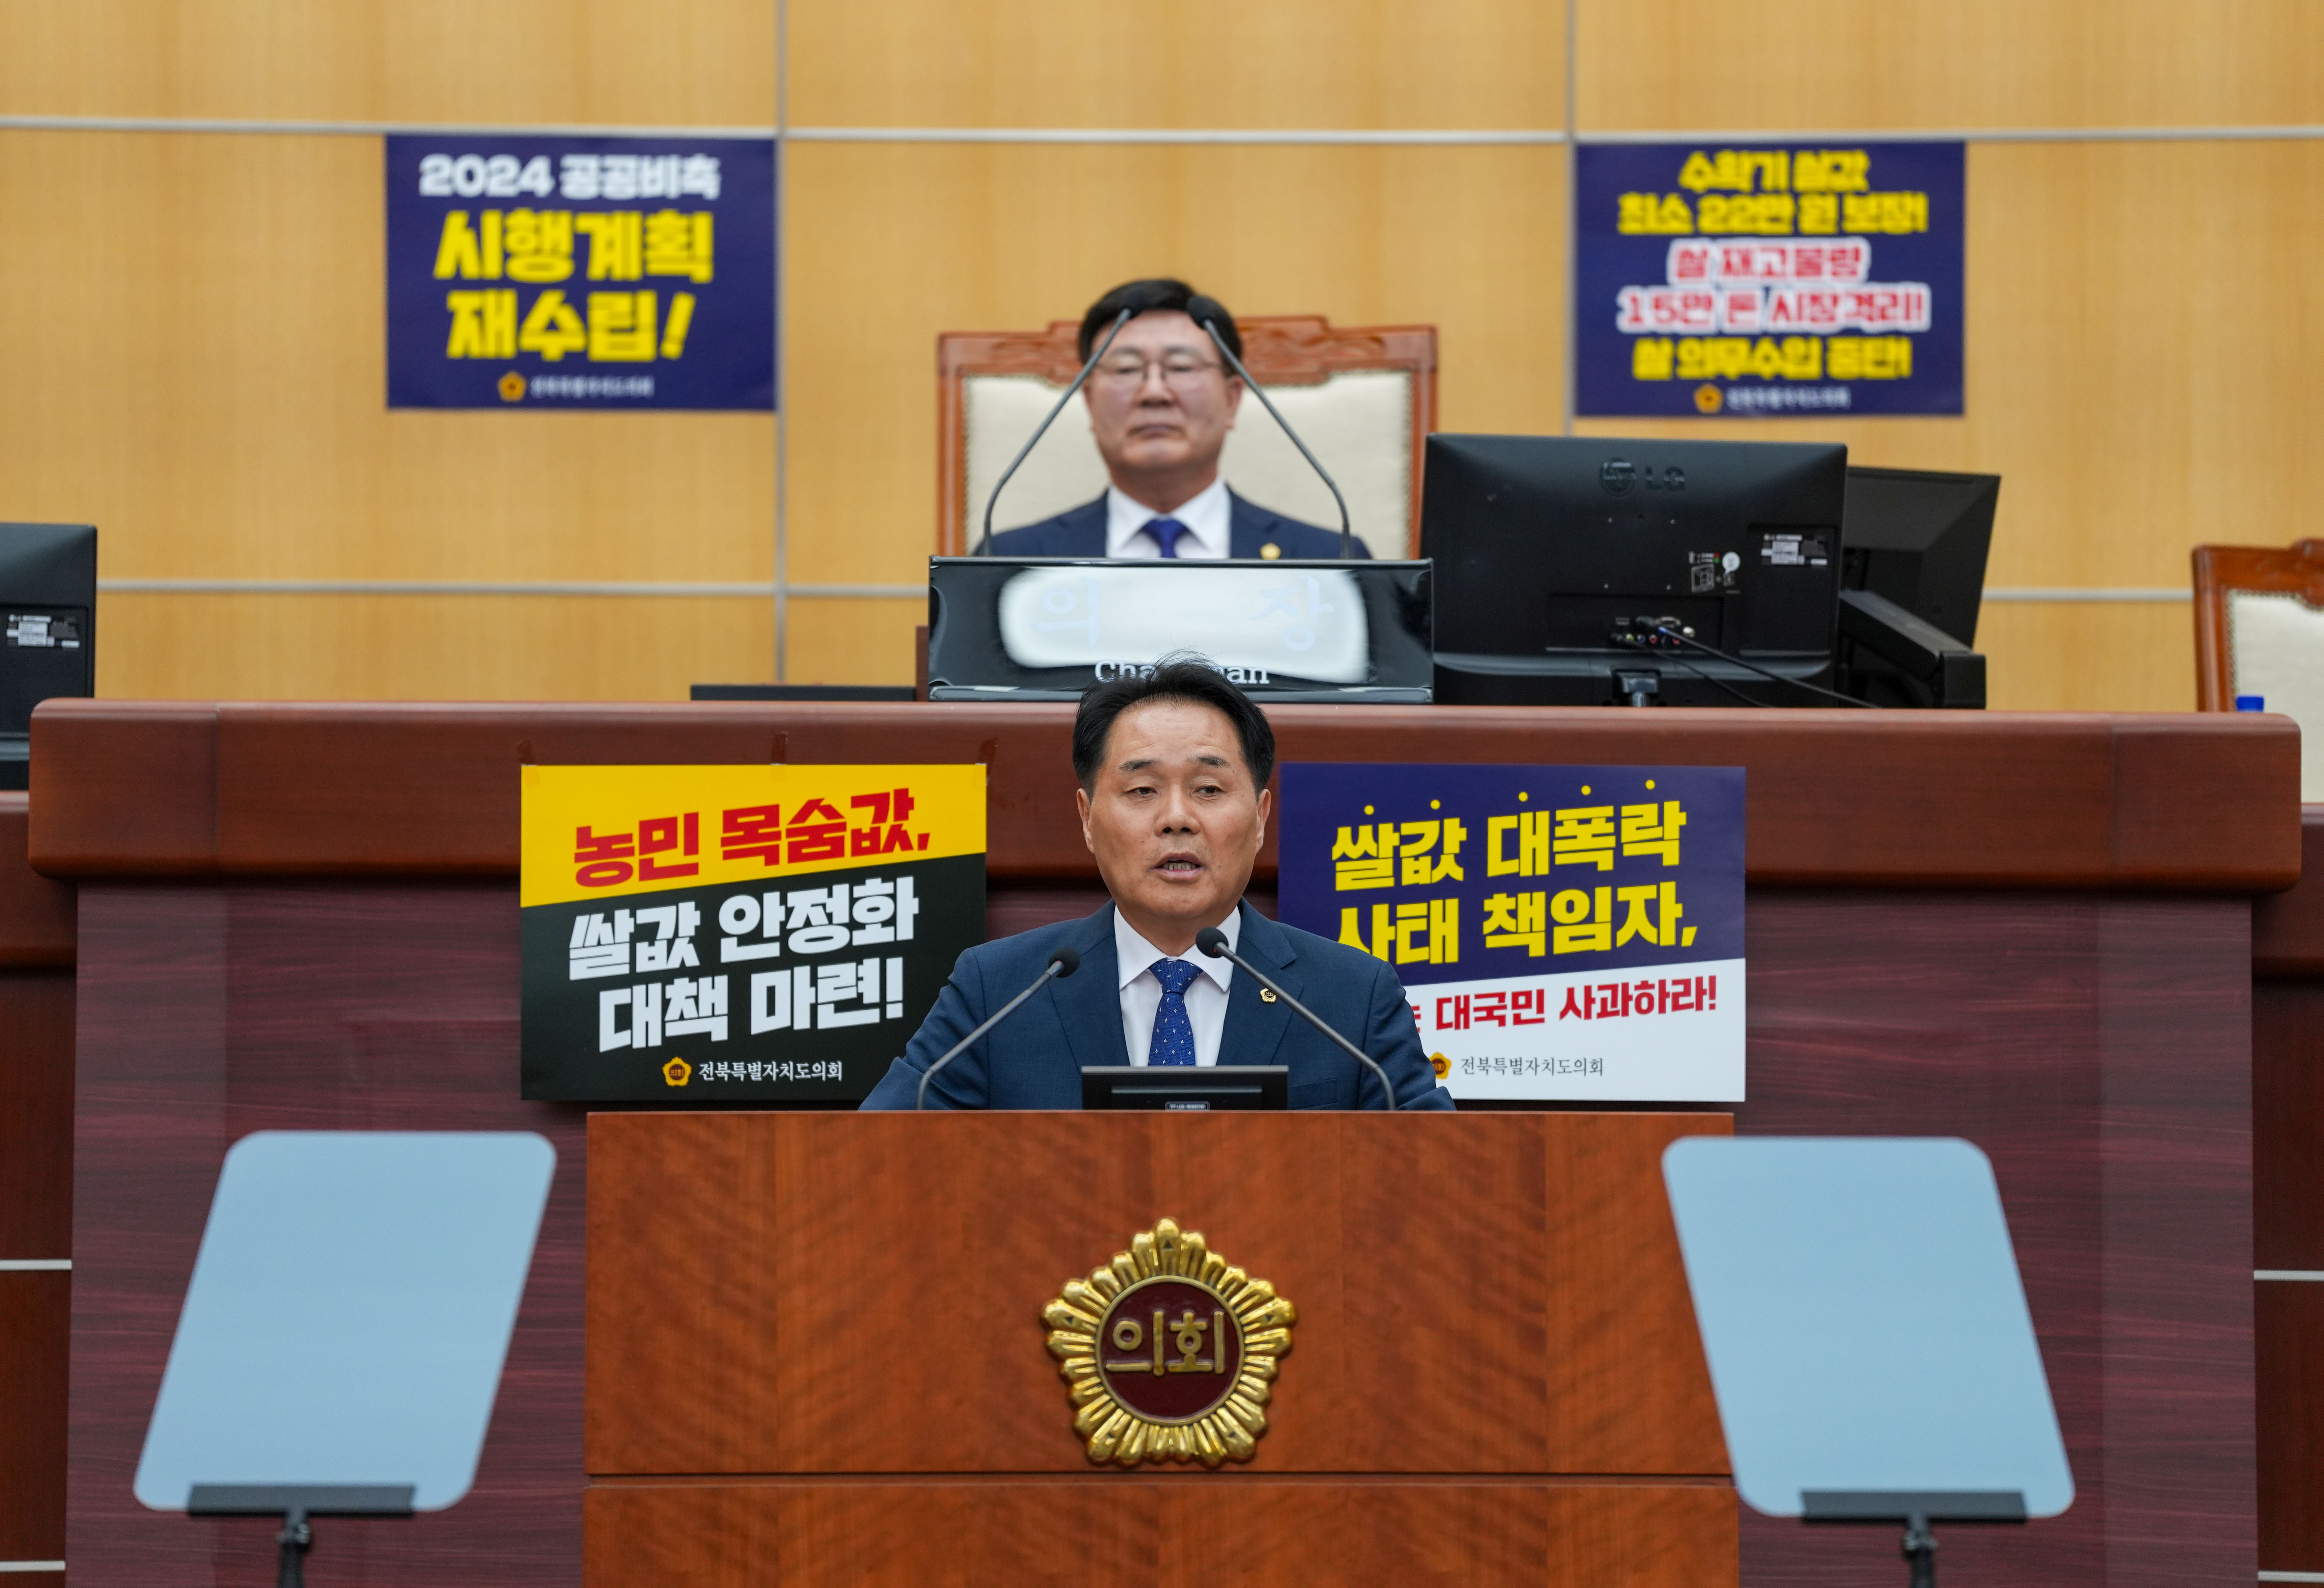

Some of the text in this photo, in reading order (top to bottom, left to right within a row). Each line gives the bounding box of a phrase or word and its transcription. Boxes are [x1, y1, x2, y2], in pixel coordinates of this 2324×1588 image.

[418, 153, 721, 199] 2024 공공비축
[1696, 192, 1795, 235] 22만
[434, 207, 713, 283] 시행계획
[1719, 243, 1865, 281] 재고물량
[447, 288, 696, 362] 재수립!
[1625, 290, 1716, 327] 15만
[1723, 290, 1761, 327] 톤
[1674, 336, 1823, 380] 의무수입
[1095, 659, 1270, 684] Chaan
[574, 787, 930, 888] 농민 목숨값,
[1331, 800, 1687, 891] 쌀값 대폭락
[569, 876, 919, 981] 쌀값 안정화
[1338, 881, 1698, 965] 사태 책임자,
[599, 957, 904, 1052] 대책 마련!
[1436, 989, 1545, 1031] 대국민
[1559, 975, 1716, 1021] 사과하라!
[698, 1061, 843, 1082] 전북특별자치도의회
[1460, 1056, 1604, 1077] 전북특별자치도의회
[1105, 1311, 1226, 1376] 의회
